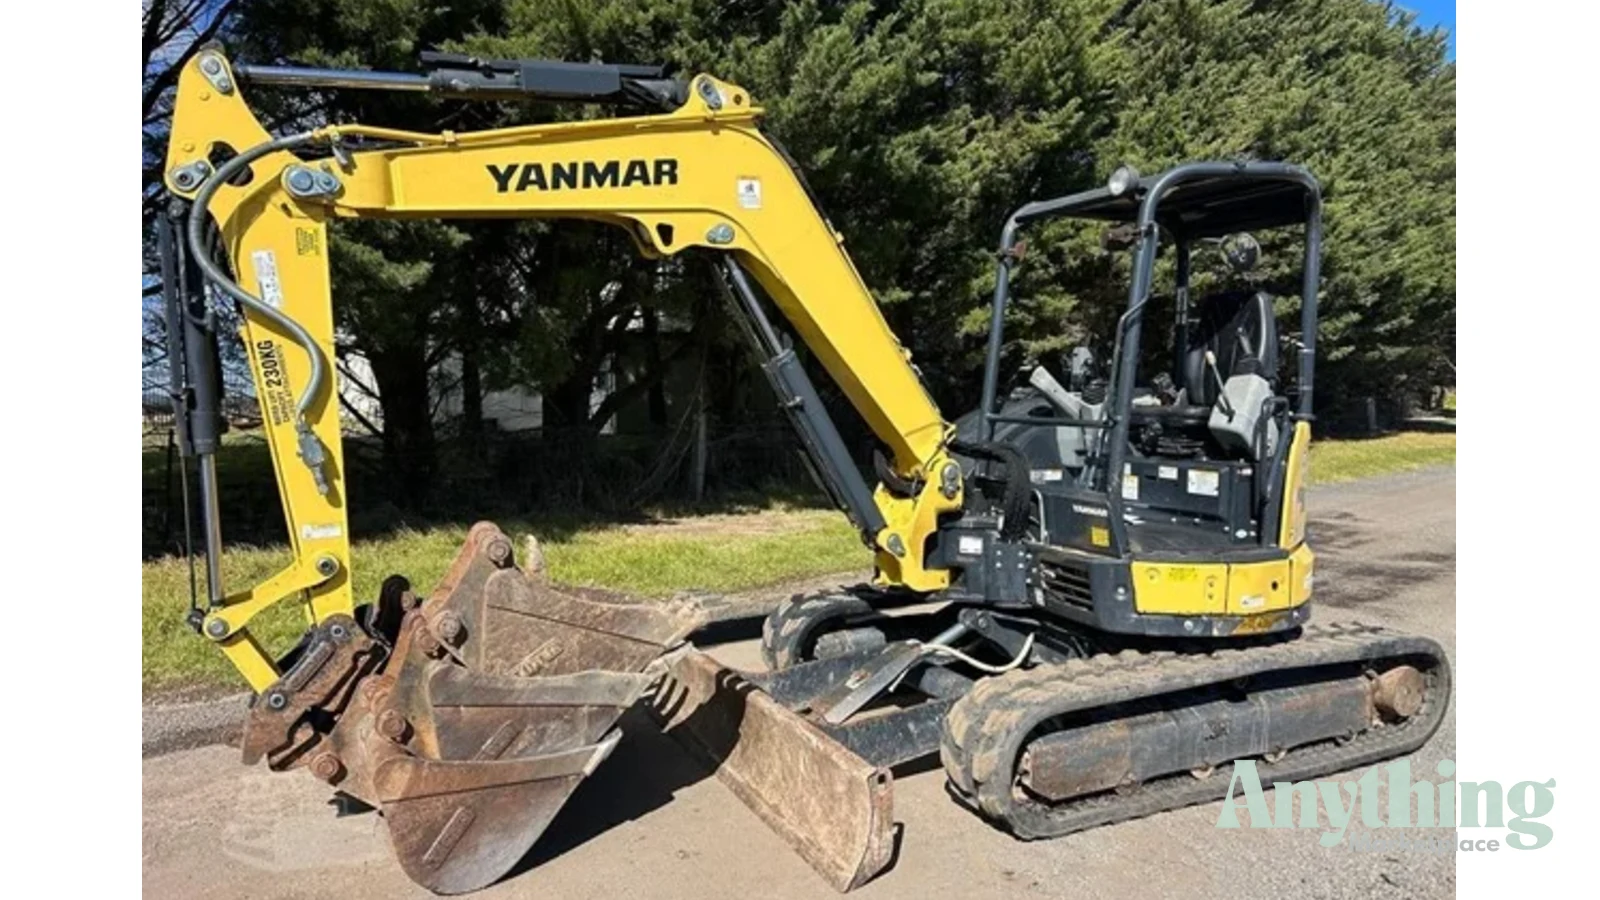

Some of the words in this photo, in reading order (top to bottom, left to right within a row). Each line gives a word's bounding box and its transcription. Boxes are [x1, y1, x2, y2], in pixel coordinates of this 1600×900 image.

[486, 158, 679, 193] YANMAR
[257, 340, 282, 388] 230KG
[1072, 504, 1108, 517] YANMAR
